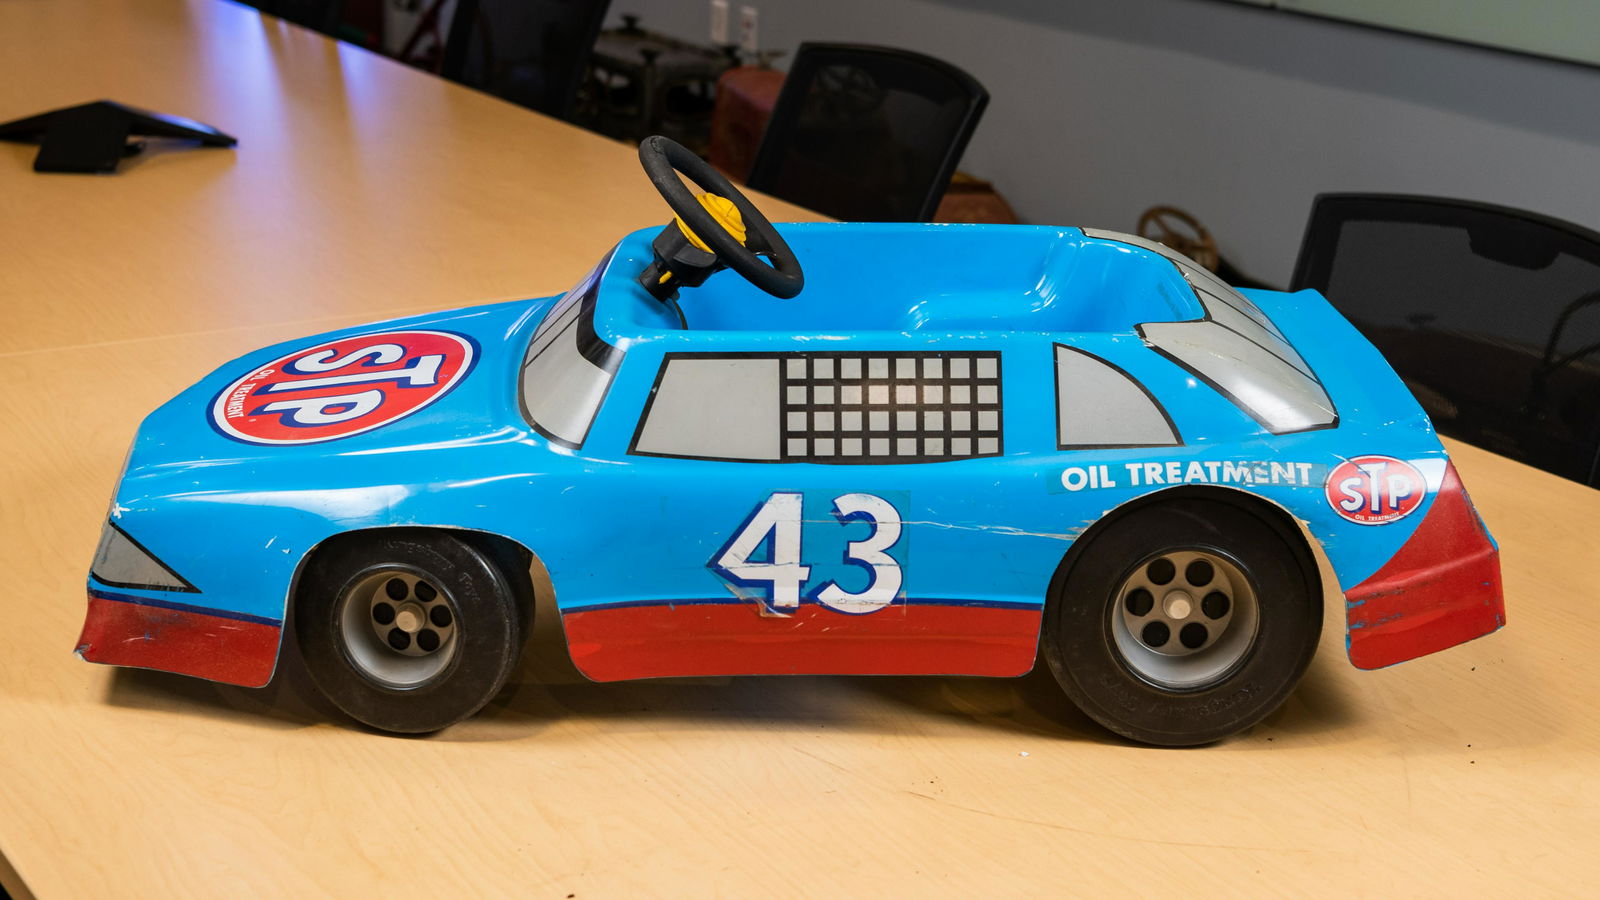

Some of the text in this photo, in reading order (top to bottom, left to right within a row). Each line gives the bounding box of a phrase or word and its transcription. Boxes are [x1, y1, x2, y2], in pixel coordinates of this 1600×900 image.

[227, 369, 275, 418] OIL TREATMENT
[252, 343, 446, 426] STP
[1061, 461, 1313, 491] OIL TREATMENT
[1339, 461, 1413, 513] STP
[707, 491, 904, 615] 43
